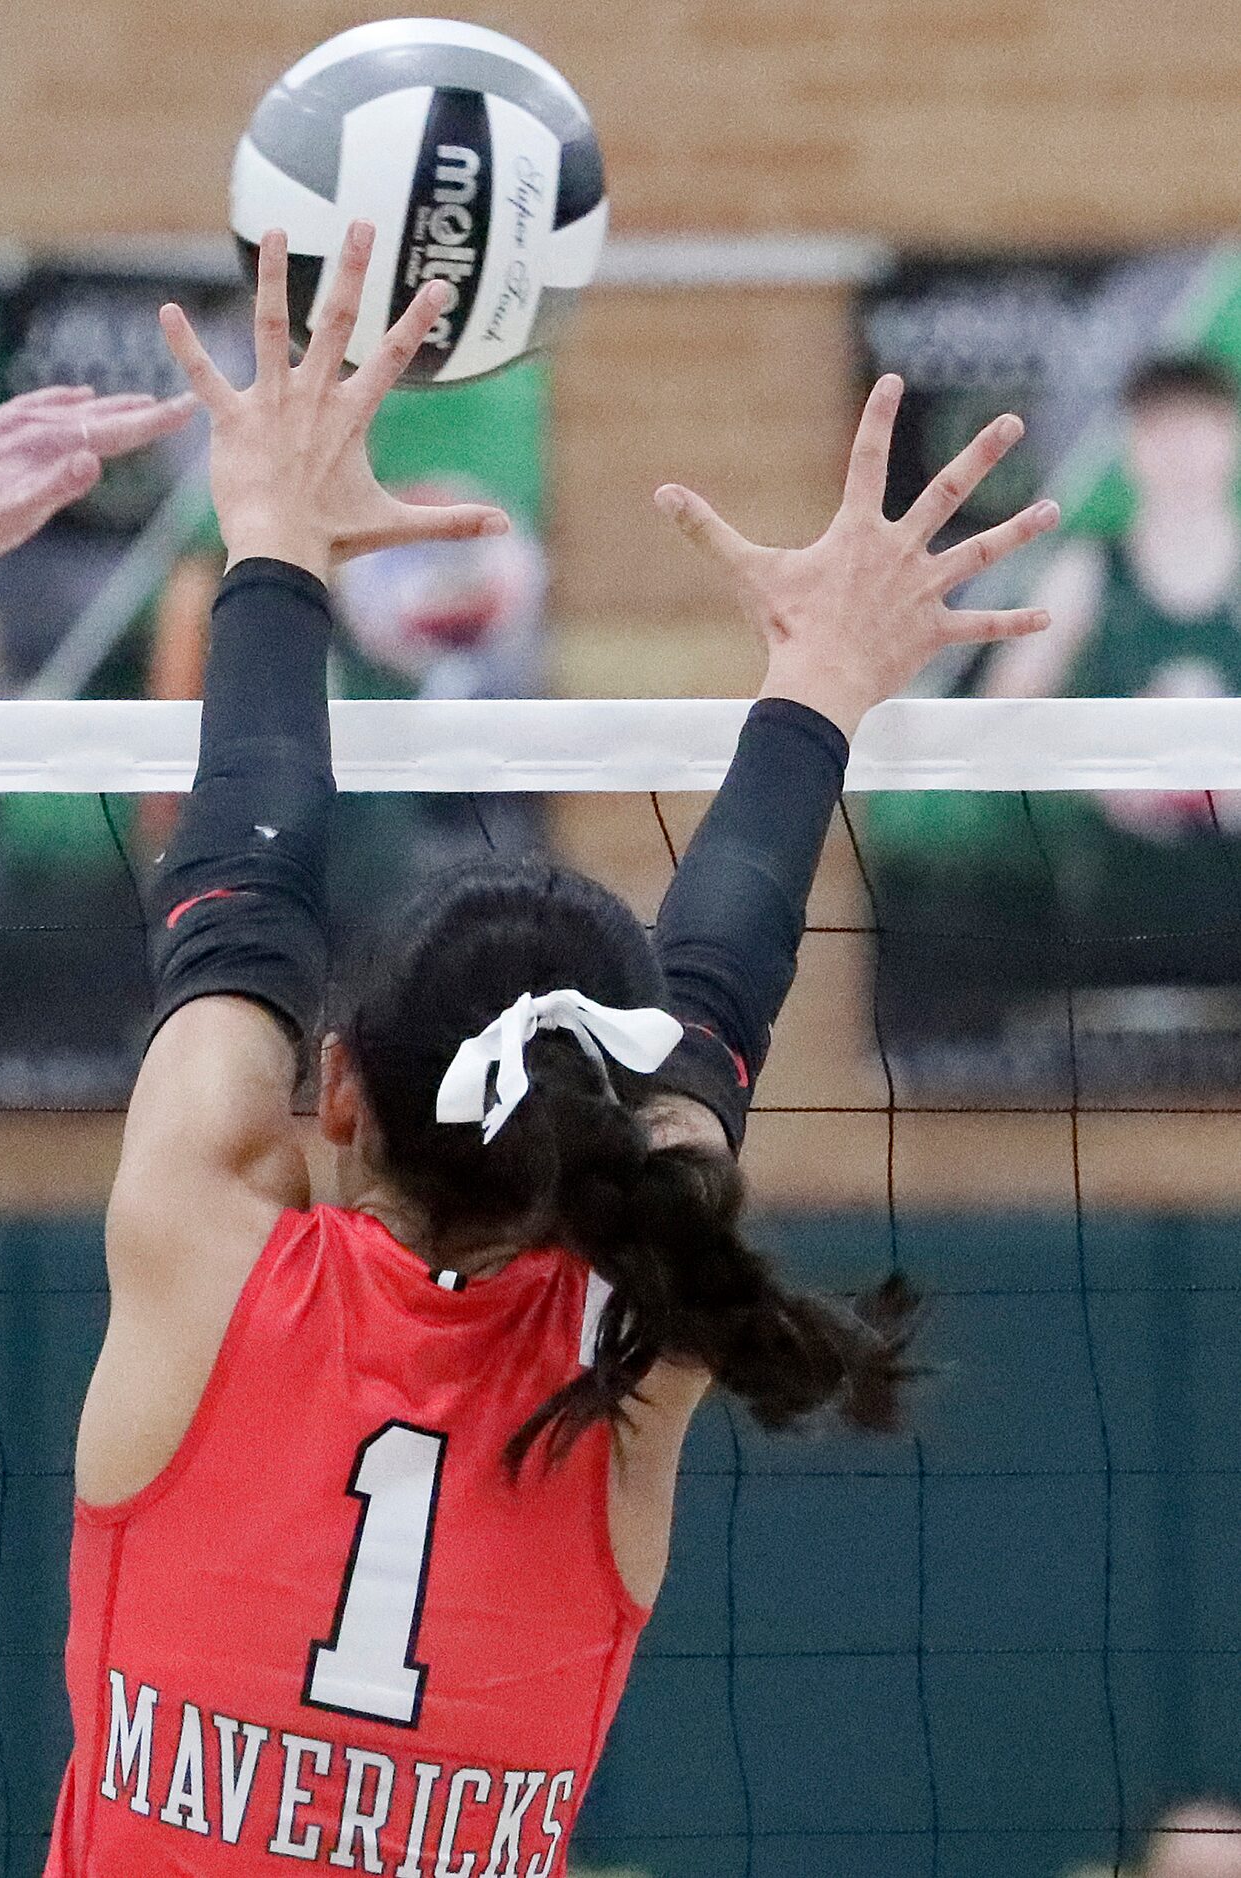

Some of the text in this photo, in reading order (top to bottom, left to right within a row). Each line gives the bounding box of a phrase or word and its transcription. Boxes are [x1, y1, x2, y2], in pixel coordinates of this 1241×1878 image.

[506, 155, 544, 248] Super
[302, 1418, 448, 1728] 1
[100, 1668, 576, 1878] MAVERICKS
